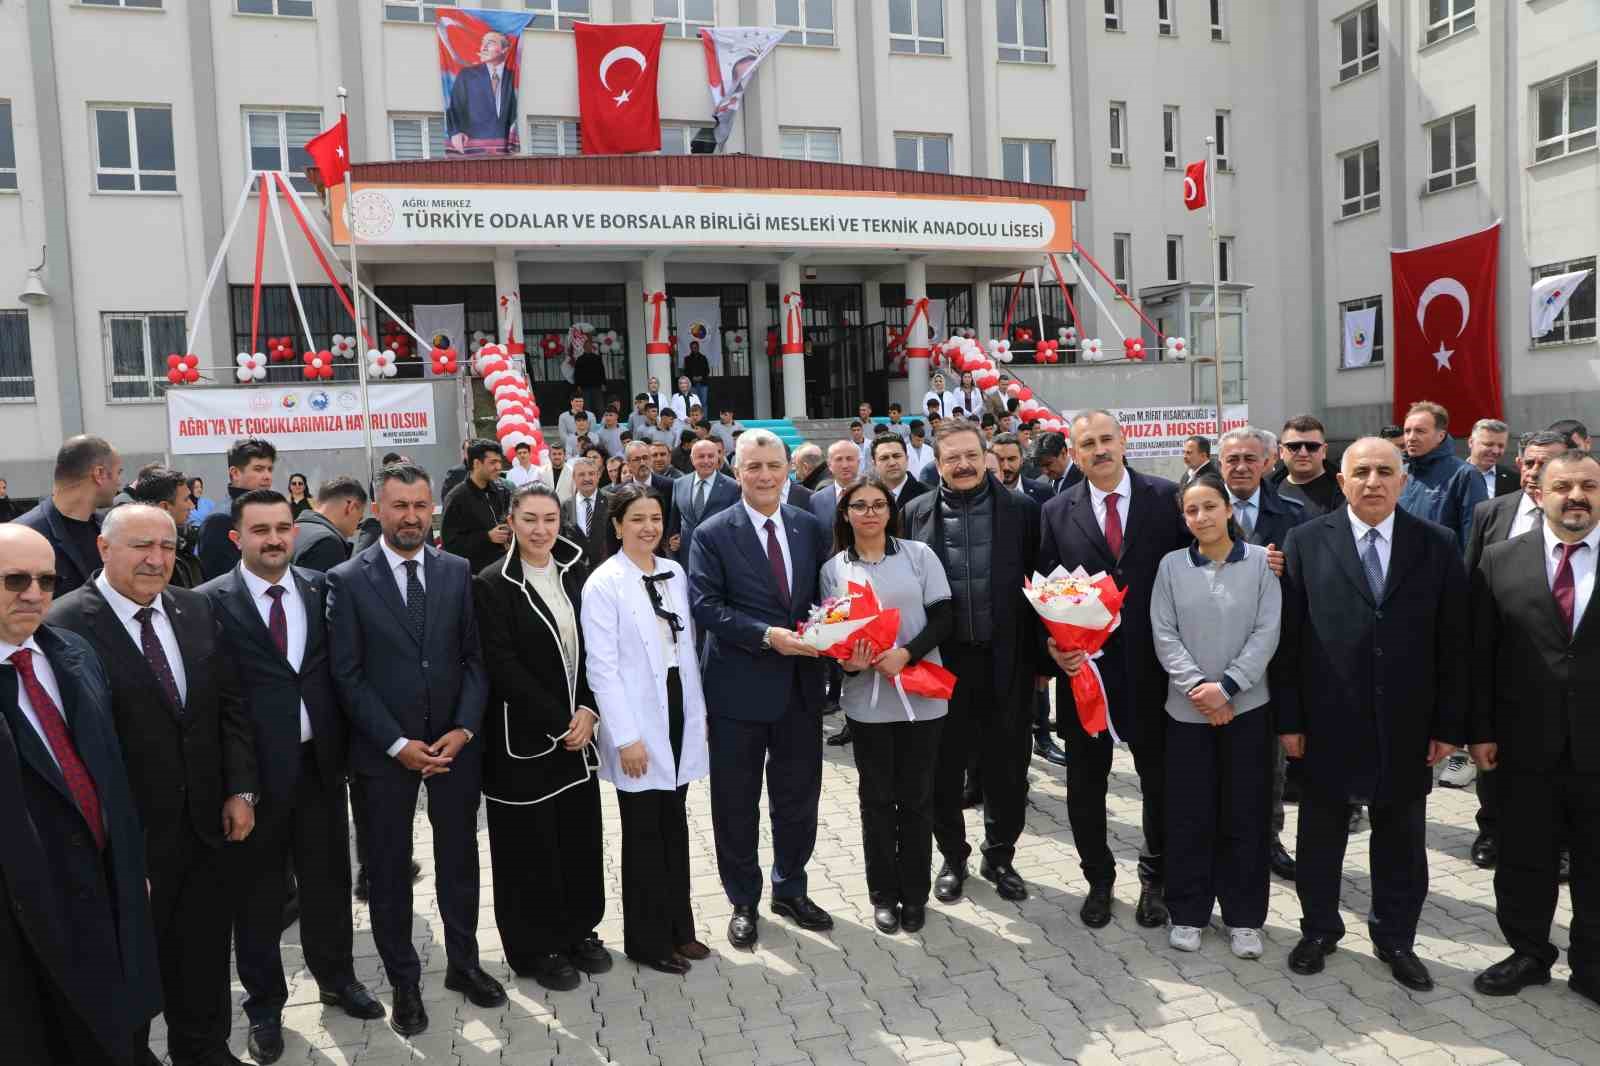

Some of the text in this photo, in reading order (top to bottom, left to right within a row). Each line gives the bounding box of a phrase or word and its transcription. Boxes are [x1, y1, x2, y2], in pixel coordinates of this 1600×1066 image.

[431, 199, 472, 208] MERKEZ
[402, 209, 1044, 237] TÜRKİYE ODALAR VE BORSALAR BİRLİĞİ MESLEKİ VE TEKNİK ANADOLU LİSESİ
[179, 416, 226, 436] AĞRI'YA
[228, 418, 243, 435] VE
[346, 412, 388, 430] HAYRLI
[391, 411, 427, 428] OLSUN
